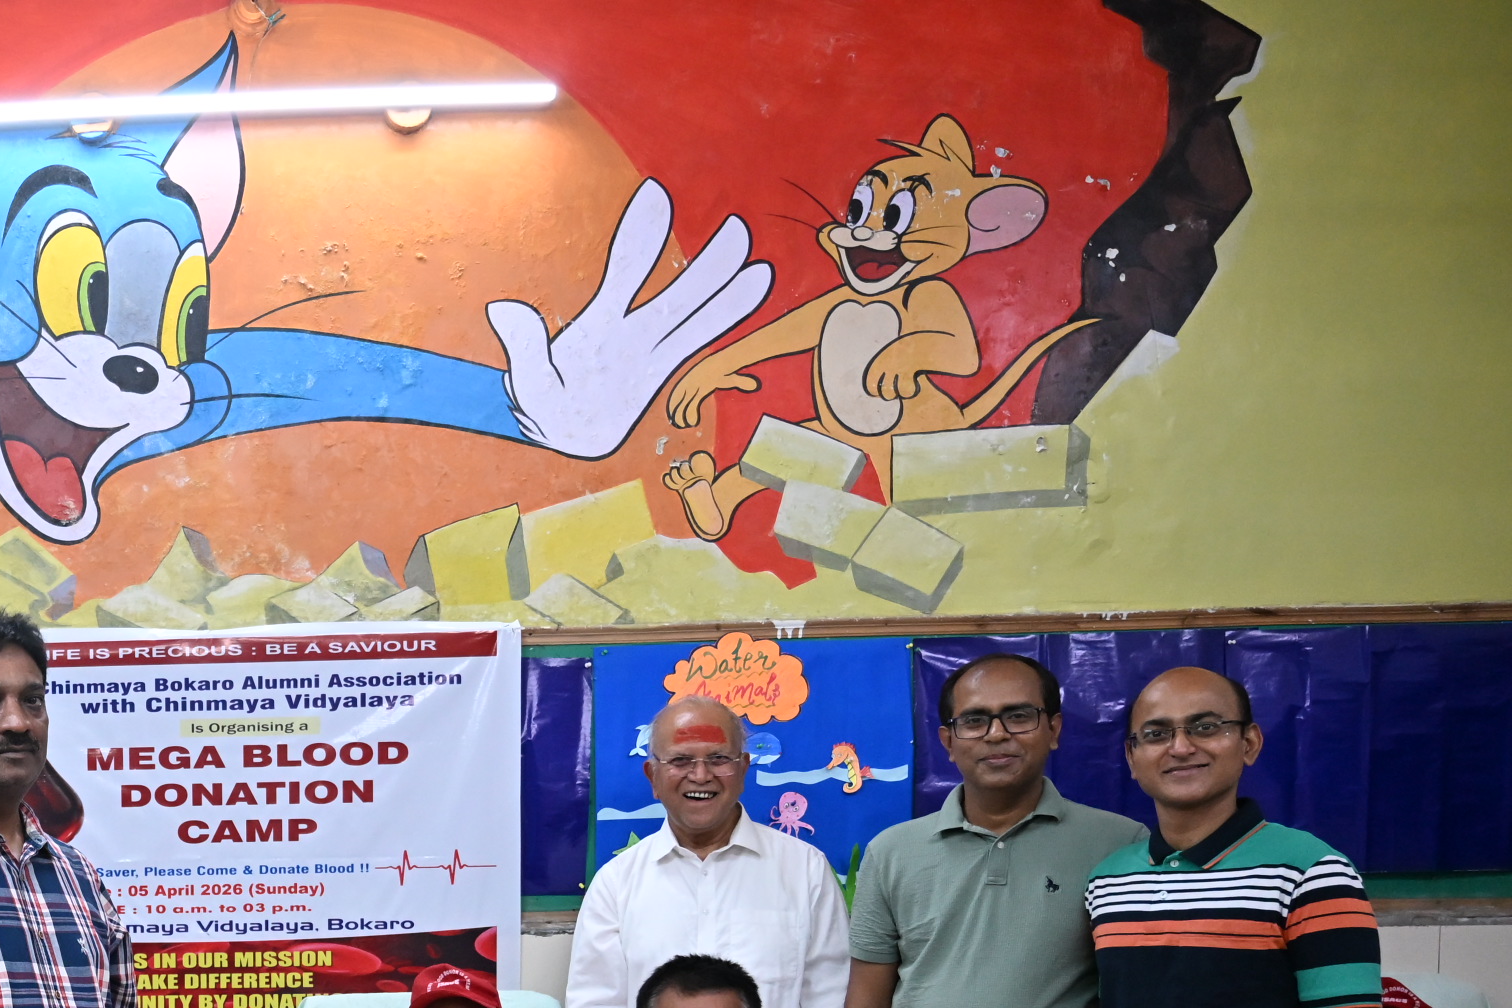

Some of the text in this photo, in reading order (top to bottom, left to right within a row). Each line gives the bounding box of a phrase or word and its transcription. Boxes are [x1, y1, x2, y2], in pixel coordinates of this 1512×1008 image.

[46, 649, 81, 661] IFE
[89, 648, 110, 659] IS
[118, 644, 243, 659] PRECIOUS
[265, 643, 298, 655] BE
[304, 642, 322, 654] A
[328, 639, 437, 654] SAVIOUR
[686, 638, 777, 682] Water
[154, 677, 234, 692] Bokaro
[242, 674, 320, 690] Alumni
[328, 671, 462, 688] Association
[81, 692, 415, 714] with Chinmaya Vidyalaya
[191, 721, 308, 735] Is Organising a
[87, 741, 409, 771] MEGA BLOOD
[120, 780, 374, 808] DONATION
[177, 818, 318, 844] CAMP
[144, 866, 192, 877] Please
[196, 865, 237, 876] Come
[242, 865, 253, 875] &
[259, 864, 309, 875] Donate
[314, 863, 355, 874] Blood
[360, 863, 370, 873] !!
[128, 885, 149, 897] 05
[154, 884, 195, 898] April
[200, 883, 243, 896] 2026
[248, 882, 325, 897] (Sunday)
[145, 904, 166, 914] 10
[172, 906, 213, 914] a.m.
[219, 904, 237, 913] to
[243, 903, 266, 913] 03
[272, 903, 313, 914] p.m.
[125, 923, 189, 936] maya
[327, 918, 415, 931] Bokaro
[153, 953, 176, 969] IN
[182, 952, 229, 969] OUR
[234, 950, 333, 968] MISSION
[137, 972, 314, 990] AKE DIFFERENCE
